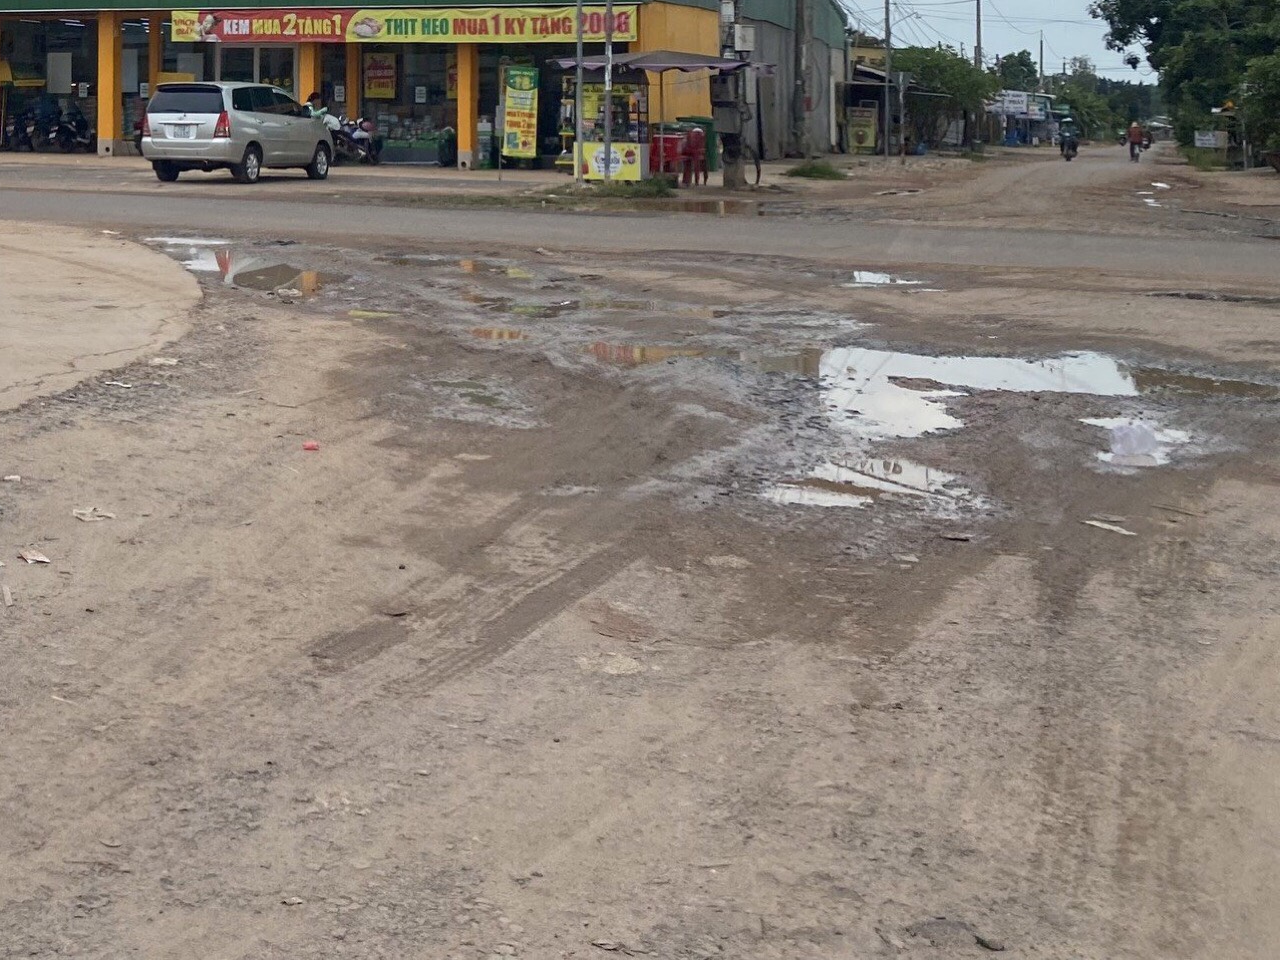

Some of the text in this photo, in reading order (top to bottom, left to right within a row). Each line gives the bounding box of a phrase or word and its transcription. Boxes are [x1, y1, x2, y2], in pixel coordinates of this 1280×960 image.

[223, 18, 250, 36] KEM
[252, 18, 280, 36] MUA
[282, 13, 297, 37] 2
[332, 14, 342, 36] 1
[421, 18, 450, 36] HEO
[452, 18, 489, 36] MUA
[491, 13, 500, 36] 1
